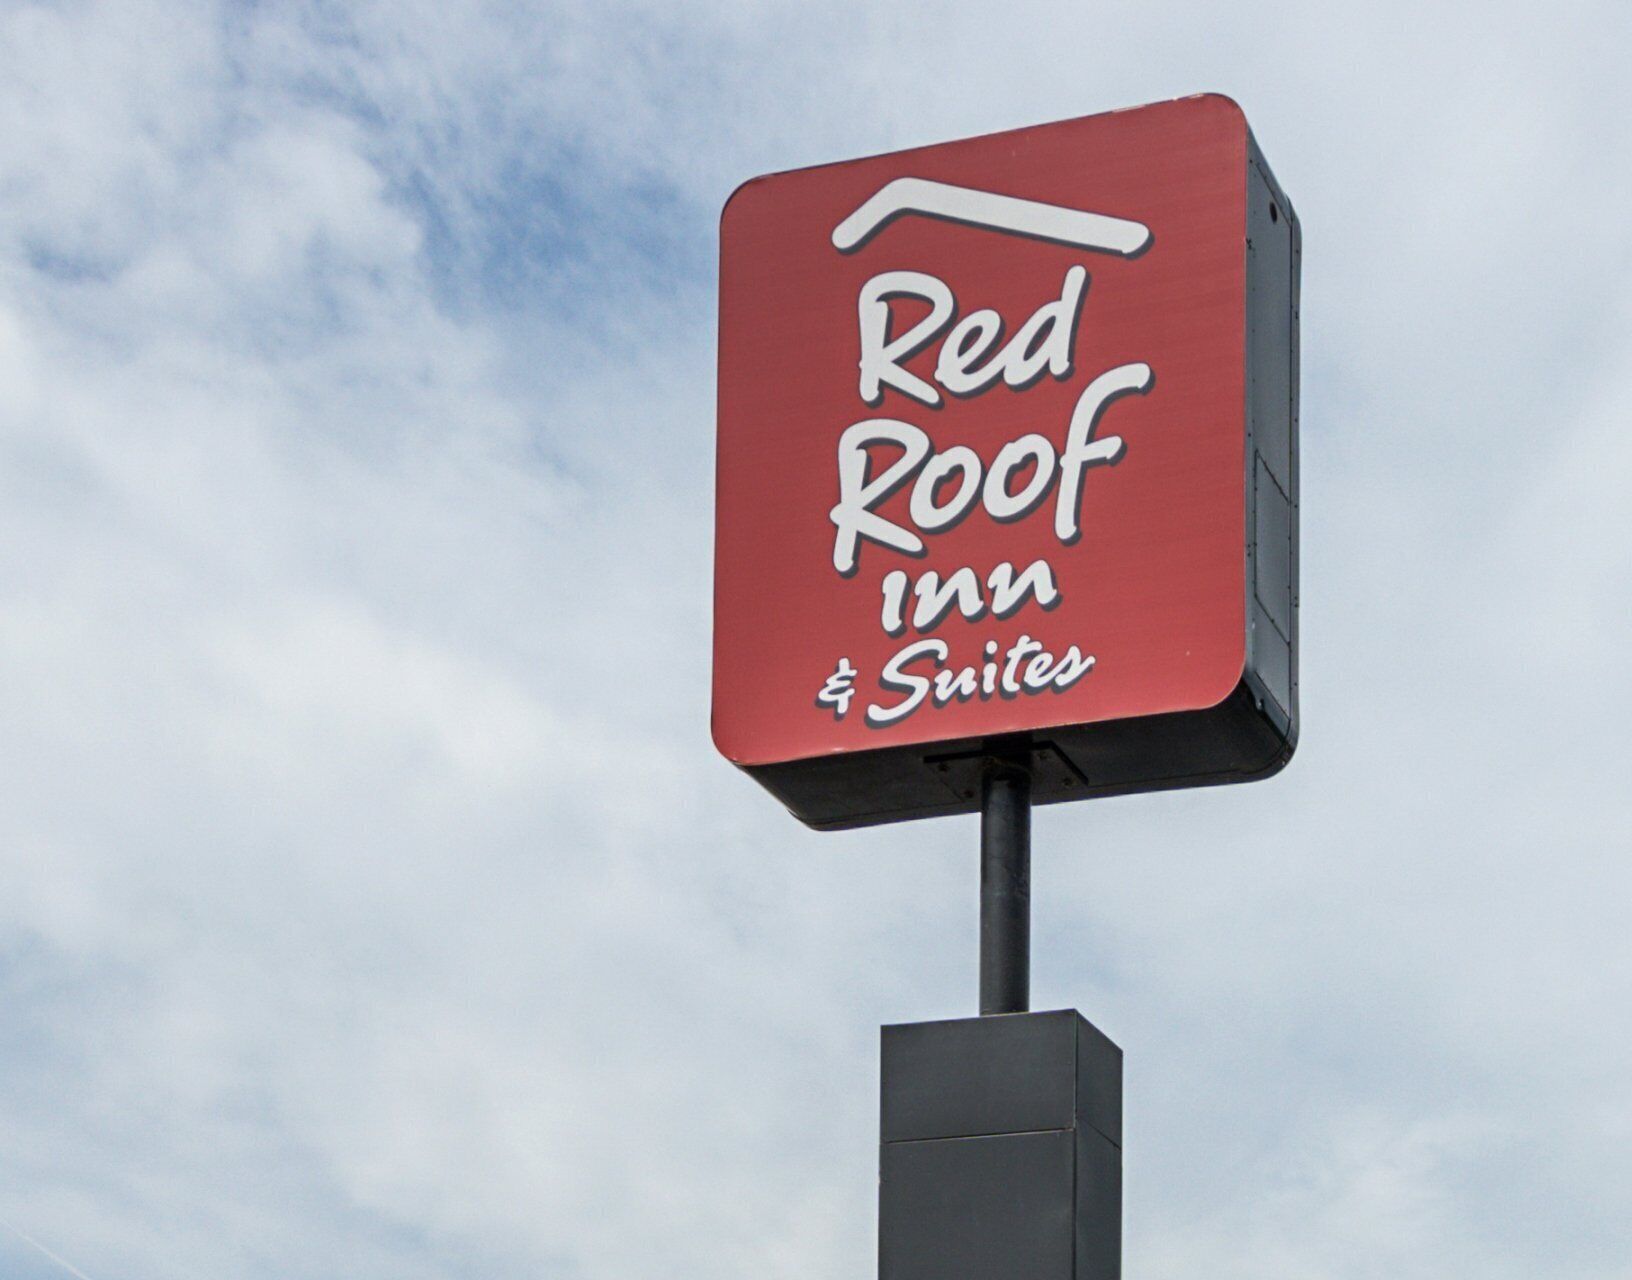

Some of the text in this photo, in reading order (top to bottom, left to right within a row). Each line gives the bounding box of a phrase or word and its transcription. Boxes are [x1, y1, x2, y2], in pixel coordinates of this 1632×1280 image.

[858, 265, 1086, 404] Red
[829, 362, 1151, 572] Roof
[818, 634, 1096, 722] & Suites
